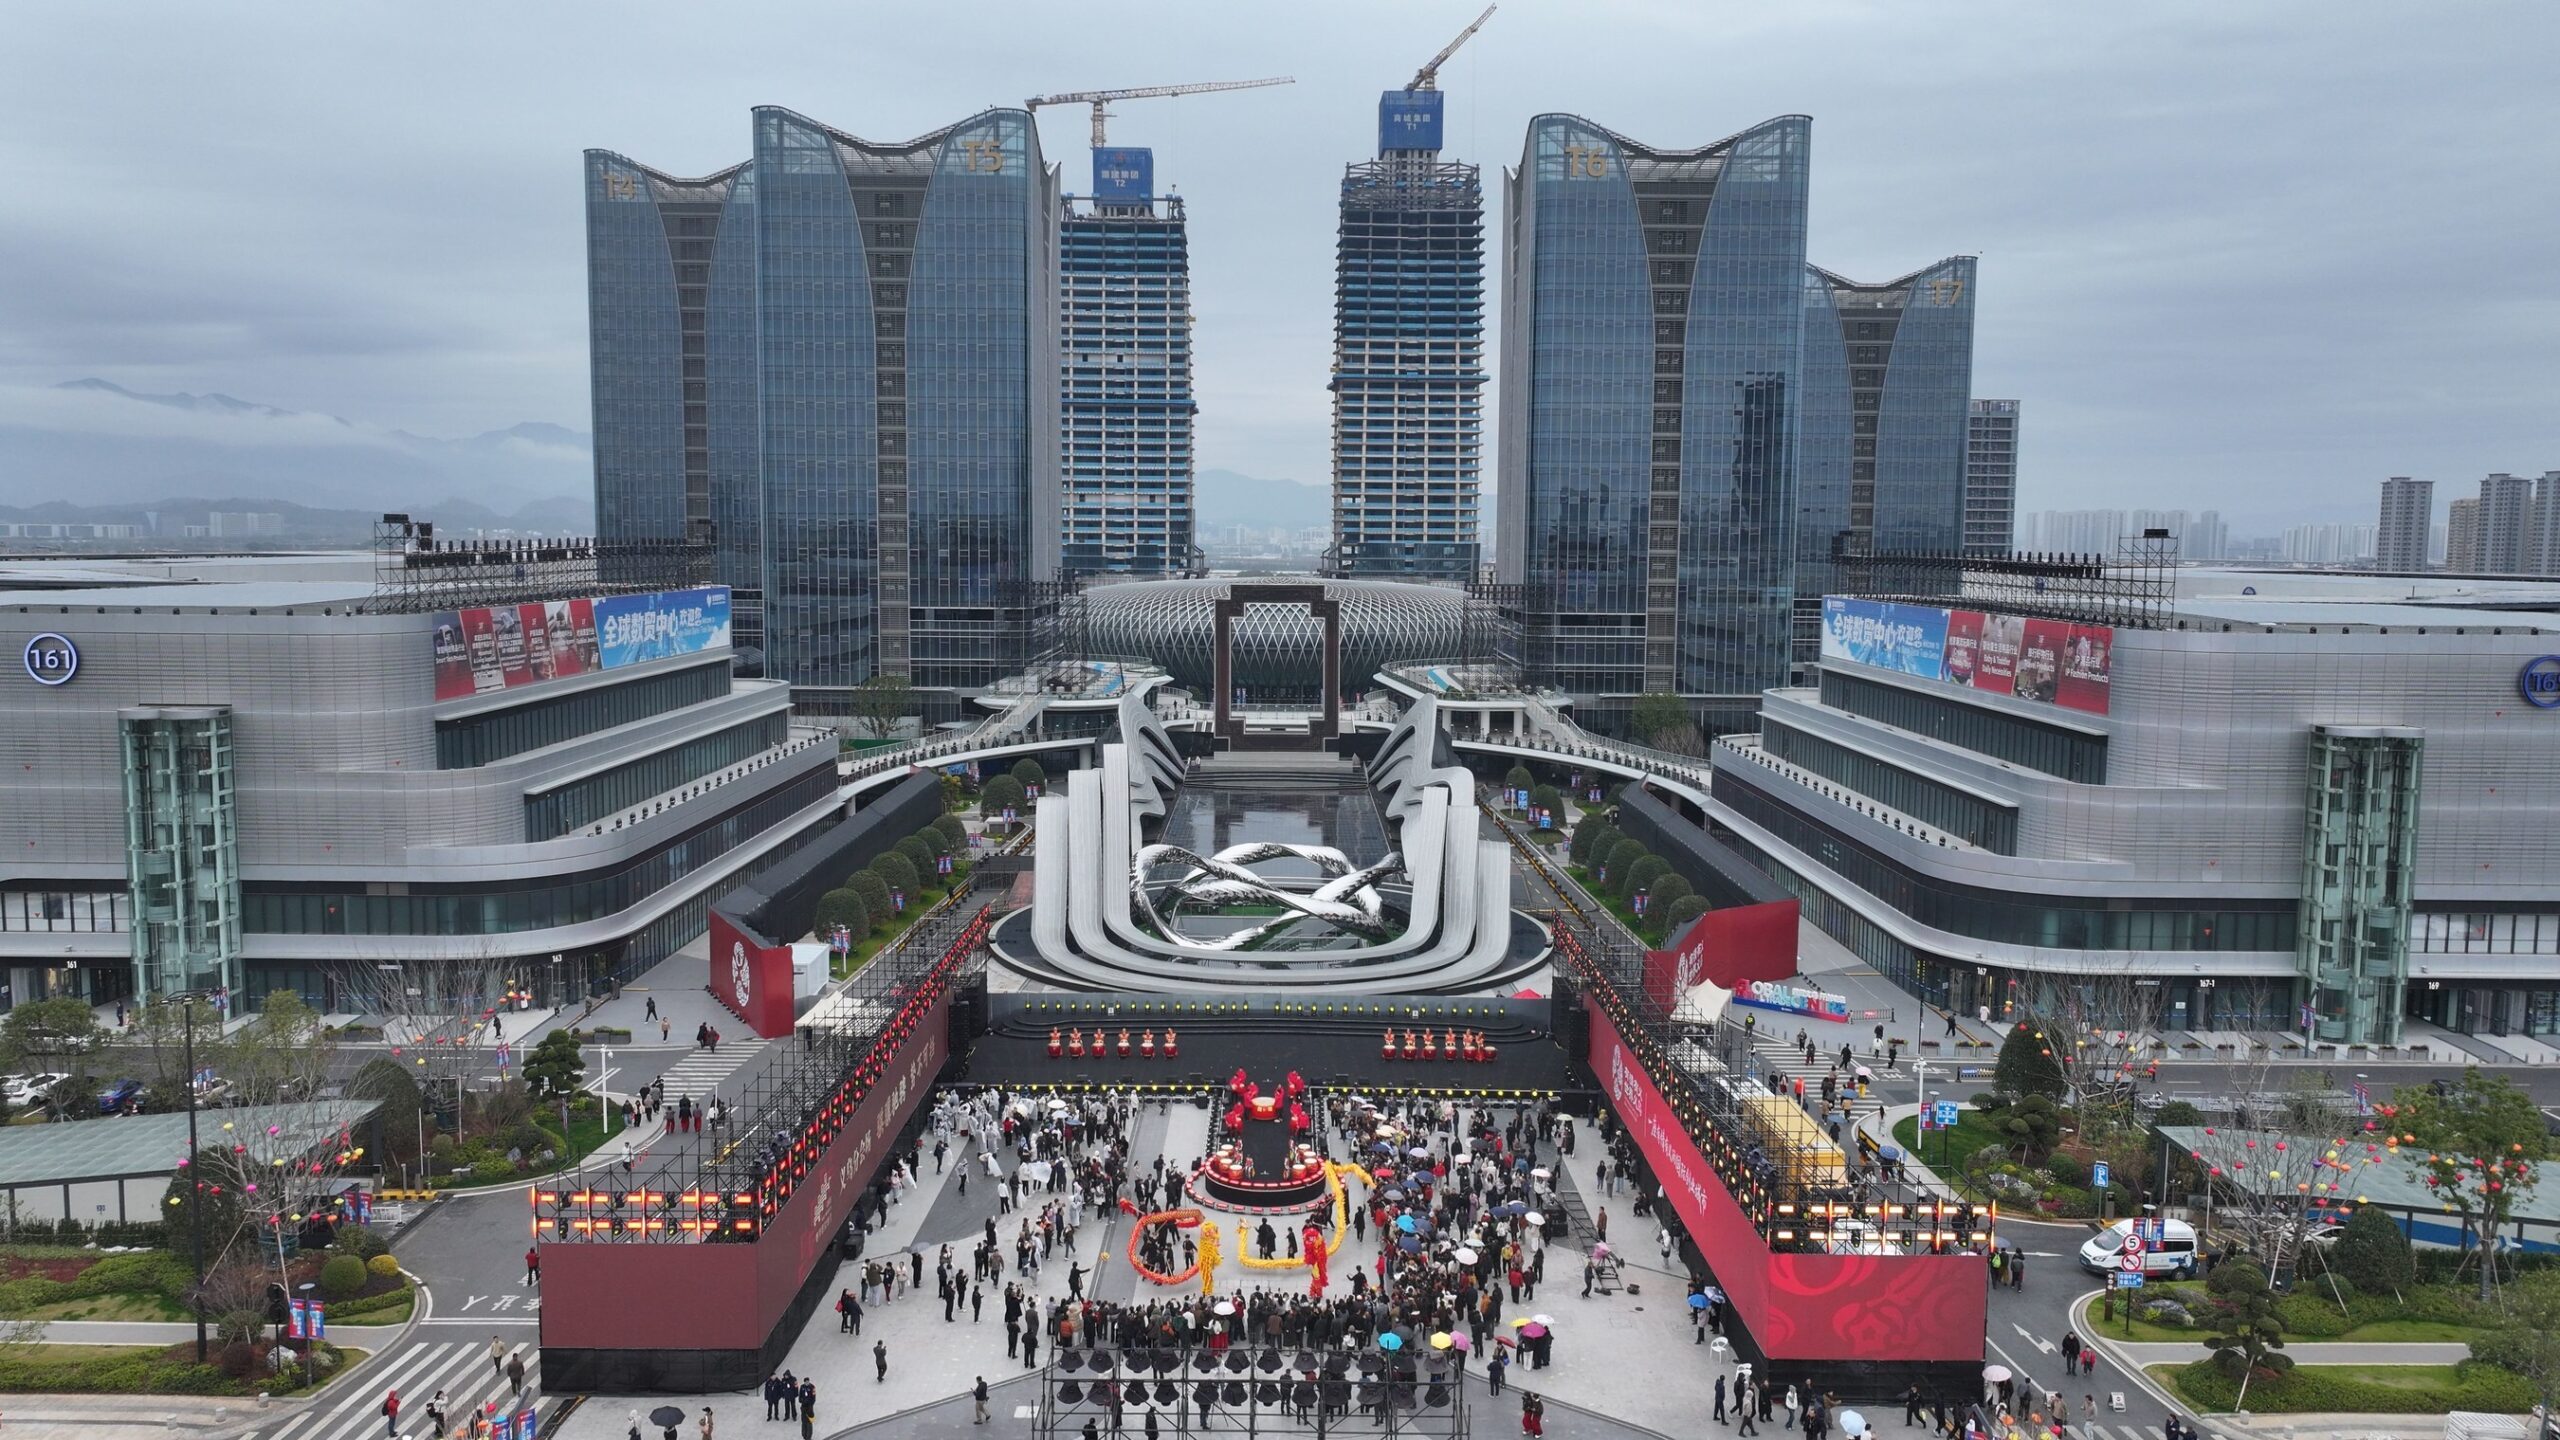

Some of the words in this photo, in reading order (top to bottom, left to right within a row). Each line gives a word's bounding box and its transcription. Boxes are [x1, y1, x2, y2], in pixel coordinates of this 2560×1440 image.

[961, 140, 1004, 172] T5
[1564, 146, 1607, 177] T6
[601, 174, 636, 199] T4
[1114, 179, 1127, 188] T2
[1929, 279, 1964, 305] T7
[603, 608, 679, 649] 全球数贸中心
[1833, 613, 1898, 651] 全球数贸中心
[30, 649, 70, 669] 161
[2087, 671, 2109, 683] Products
[2531, 671, 2560, 693] 16
[2199, 979, 2216, 988] 167-1
[2128, 1237, 2137, 1248] 5
